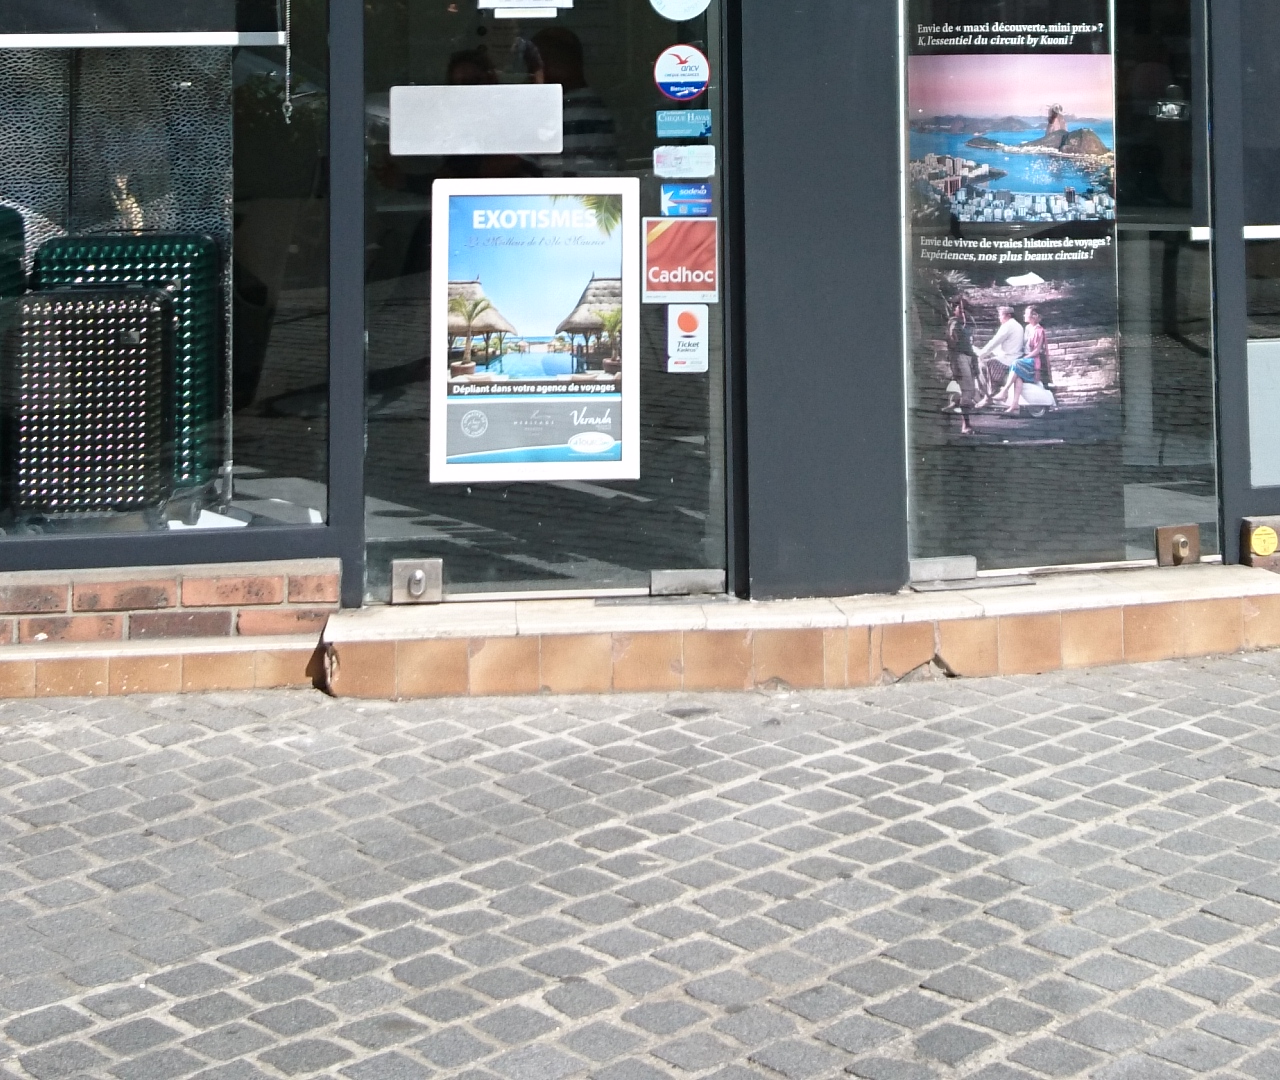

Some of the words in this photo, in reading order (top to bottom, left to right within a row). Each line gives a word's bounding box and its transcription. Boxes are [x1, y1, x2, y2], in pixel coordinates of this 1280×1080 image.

[917, 23, 941, 34] Envie
[942, 23, 954, 33] de
[963, 23, 990, 33] maxi
[1048, 22, 1069, 33] mini
[974, 34, 989, 45] du
[991, 34, 1025, 45] circuit
[1026, 34, 1039, 48] by
[473, 208, 598, 230] EXOTISMES
[920, 236, 942, 247] Envie
[942, 236, 954, 247] de
[954, 237, 978, 248] vivre
[980, 237, 992, 248] de
[993, 238, 1023, 248] vraies
[1023, 237, 1063, 248] histoires
[1063, 237, 1074, 247] de
[920, 249, 976, 262] Expériences,
[978, 252, 997, 262] nos
[998, 250, 1023, 264] plus
[1024, 250, 1053, 261] beaux
[648, 266, 714, 284] Cadhoc
[677, 340, 700, 348] Ticket
[453, 384, 490, 395] Dépliant
[491, 384, 512, 393] dans
[513, 385, 535, 393] votre
[536, 385, 567, 394] agence
[568, 384, 579, 392] de
[580, 384, 616, 394] voyages
